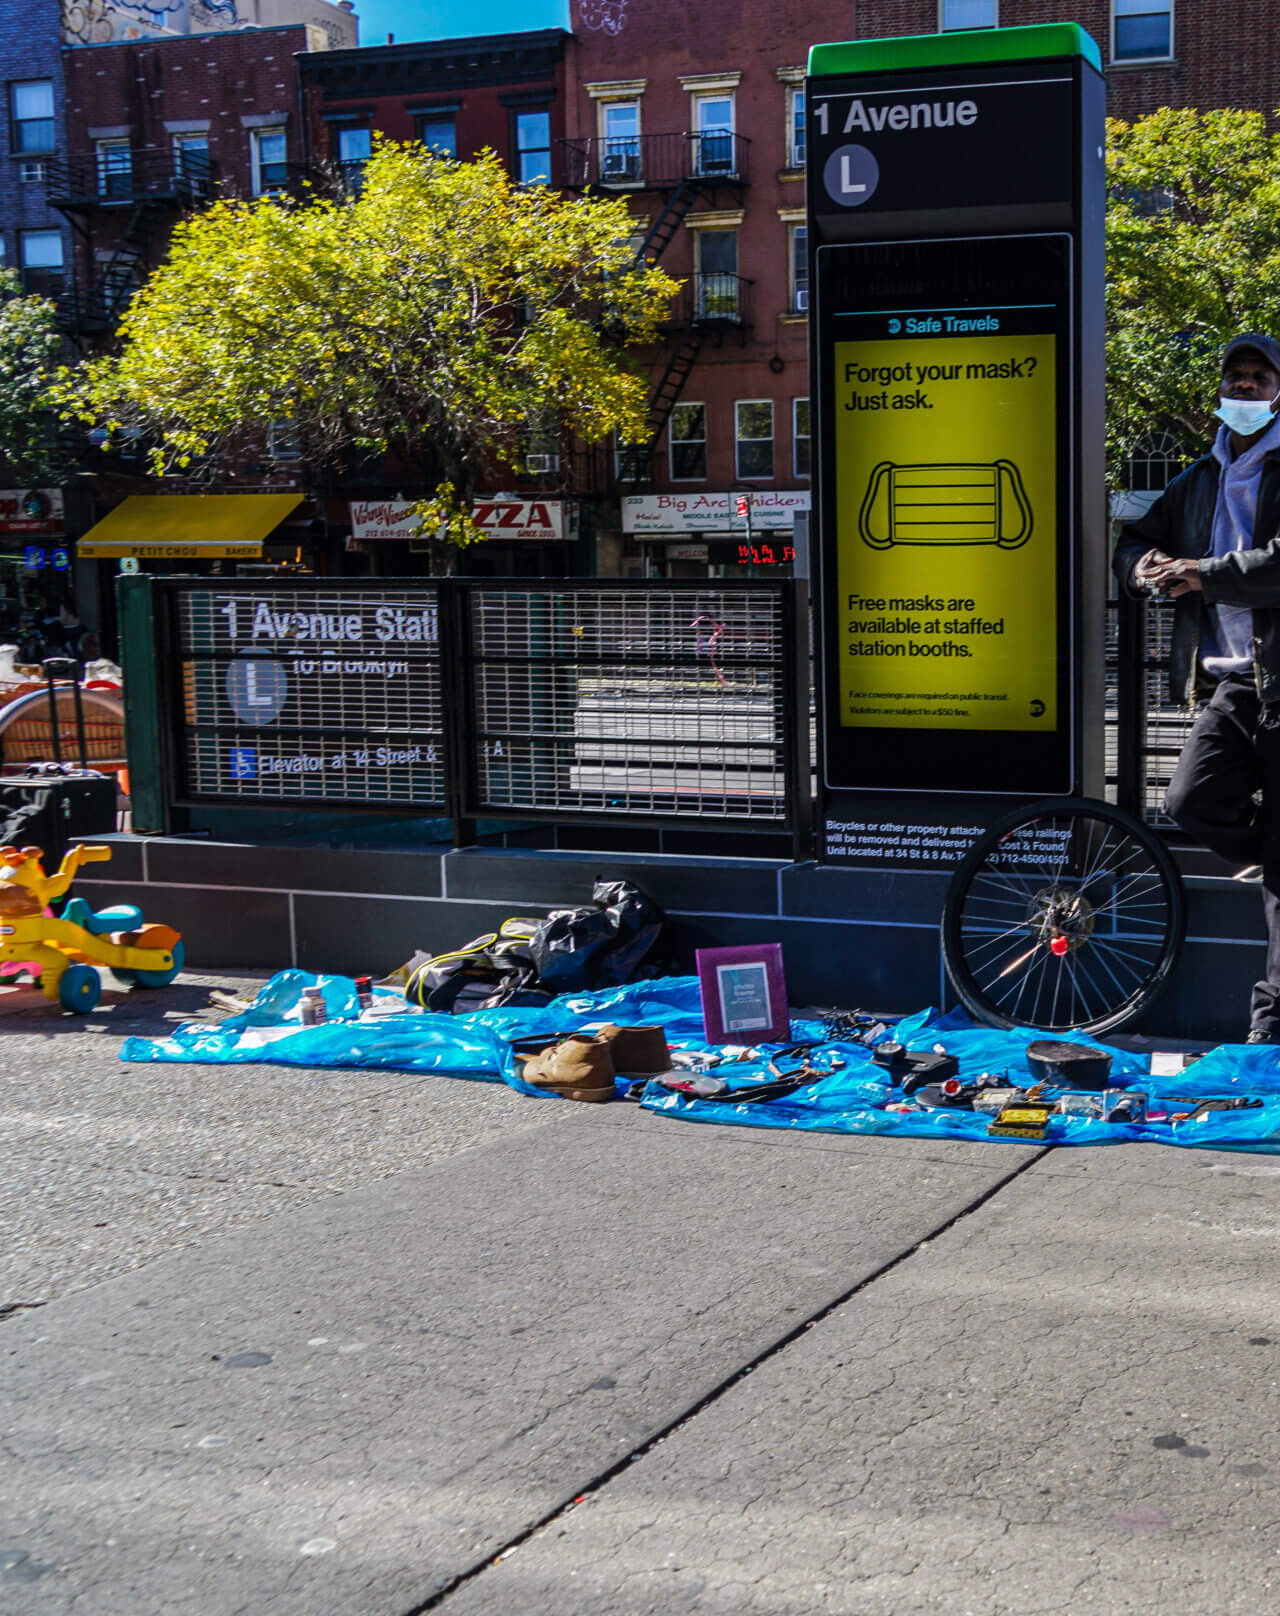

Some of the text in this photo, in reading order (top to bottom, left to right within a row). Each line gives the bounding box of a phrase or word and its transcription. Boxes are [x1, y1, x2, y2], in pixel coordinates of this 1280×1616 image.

[813, 99, 978, 135] 1 Avenue
[841, 155, 866, 193] L
[905, 317, 942, 333] Safe
[943, 315, 1000, 332] Travels
[845, 356, 1038, 386] Forgot your mask?
[845, 390, 934, 411] Just ask.
[657, 495, 687, 512] Big
[692, 496, 729, 509] Arc
[471, 504, 554, 528] ZZA
[132, 547, 198, 556] PETIT CHOU
[848, 595, 975, 611] Free masks are
[221, 601, 237, 638] 1
[252, 602, 361, 640] Avenue
[848, 618, 1004, 634] available at staffed
[848, 640, 973, 657] station booths.
[246, 661, 272, 706] L
[258, 753, 323, 775] Elevator
[331, 753, 346, 769] at
[352, 750, 369, 767] 14
[376, 747, 420, 767] Street
[426, 746, 437, 761] &
[826, 820, 862, 833] Bicycles
[864, 824, 878, 832] or
[880, 822, 905, 833] other
[907, 823, 948, 836] property
[1035, 828, 1072, 840] railings
[826, 833, 843, 843] will
[844, 834, 856, 843] be
[858, 835, 904, 845] removed
[907, 836, 920, 846] and
[922, 837, 967, 848] delivered
[998, 841, 1020, 850] Lost
[1022, 841, 1031, 851] &
[1032, 841, 1065, 852] Found
[826, 846, 846, 856] Unit
[848, 846, 882, 858] located
[884, 848, 893, 858] at
[896, 849, 908, 859] 34
[909, 849, 921, 859] St
[922, 849, 930, 860] &
[931, 850, 938, 860] 8
